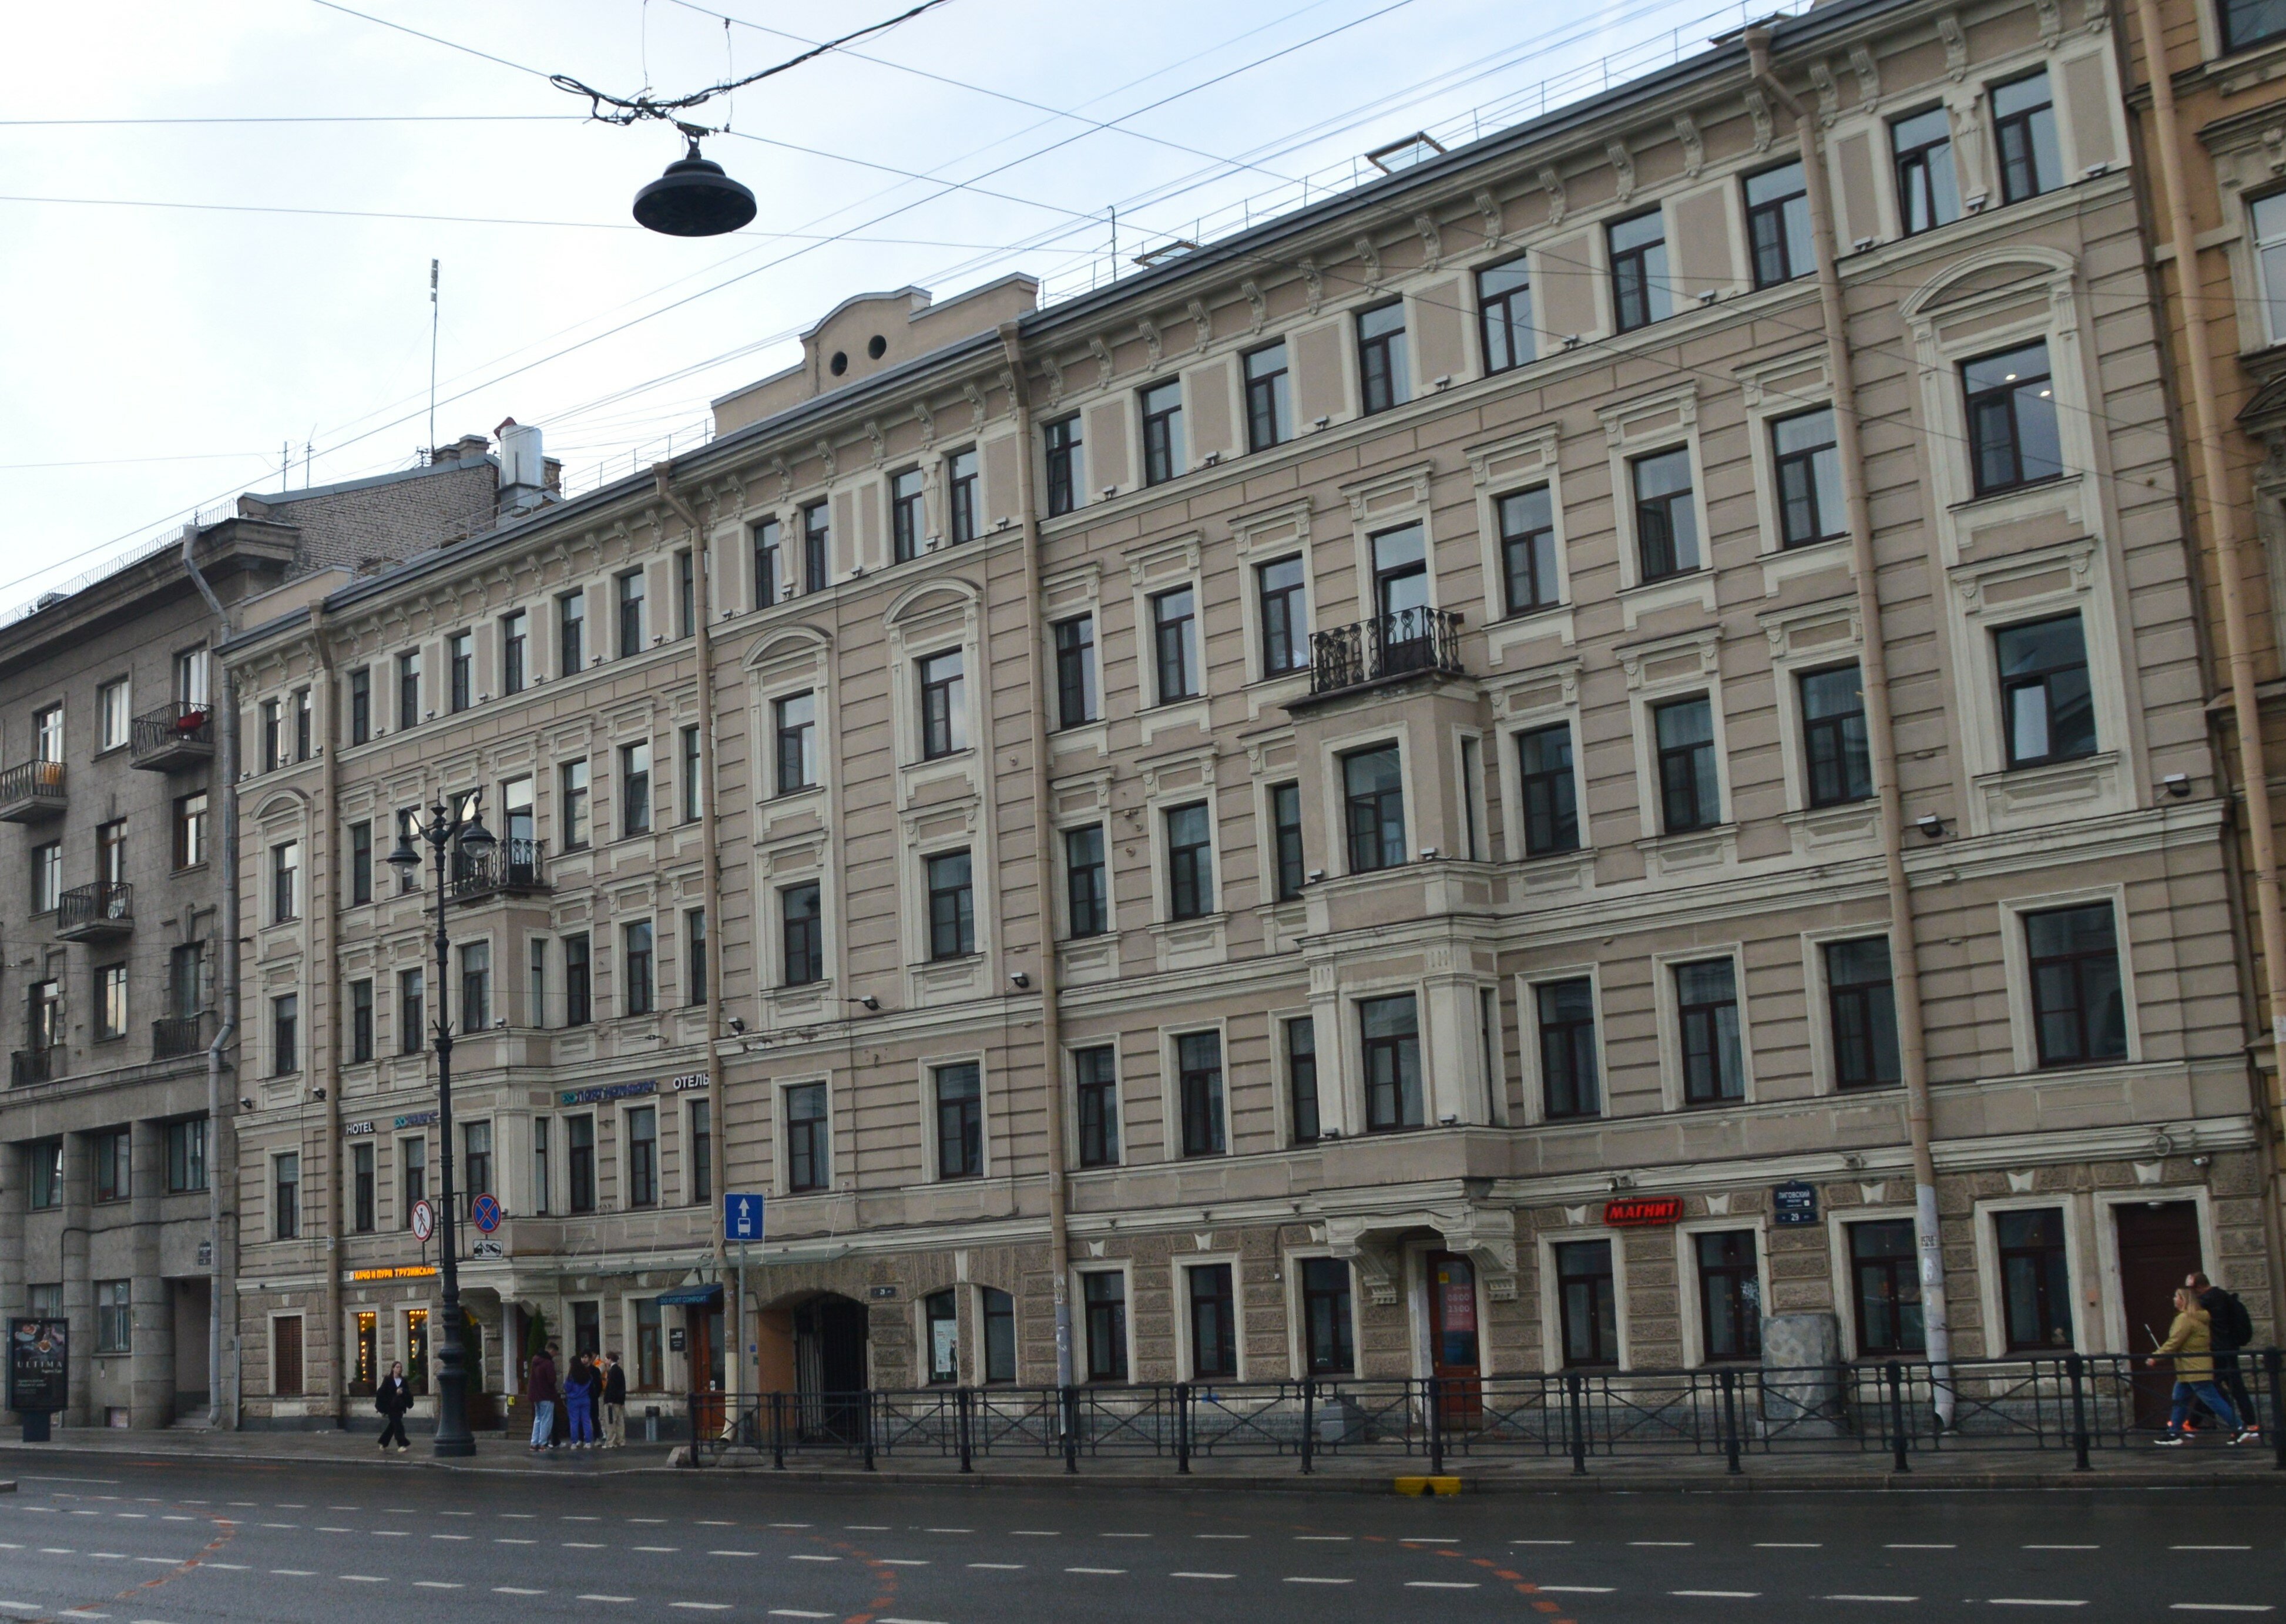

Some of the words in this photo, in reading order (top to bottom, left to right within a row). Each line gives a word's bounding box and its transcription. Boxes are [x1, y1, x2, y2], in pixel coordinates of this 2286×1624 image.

[673, 1074, 709, 1089] ОТЕЛЬ
[347, 1122, 373, 1135] HOTEL
[1778, 1190, 1810, 1199] ЛИГОВСКИЙ
[1610, 1202, 1676, 1219] МАГНИТ
[354, 1270, 371, 1280] ХАЧО
[371, 1270, 376, 1279] И
[377, 1269, 393, 1279] ПУРИ
[395, 1266, 436, 1277] ГРУЗИНСКАЯ
